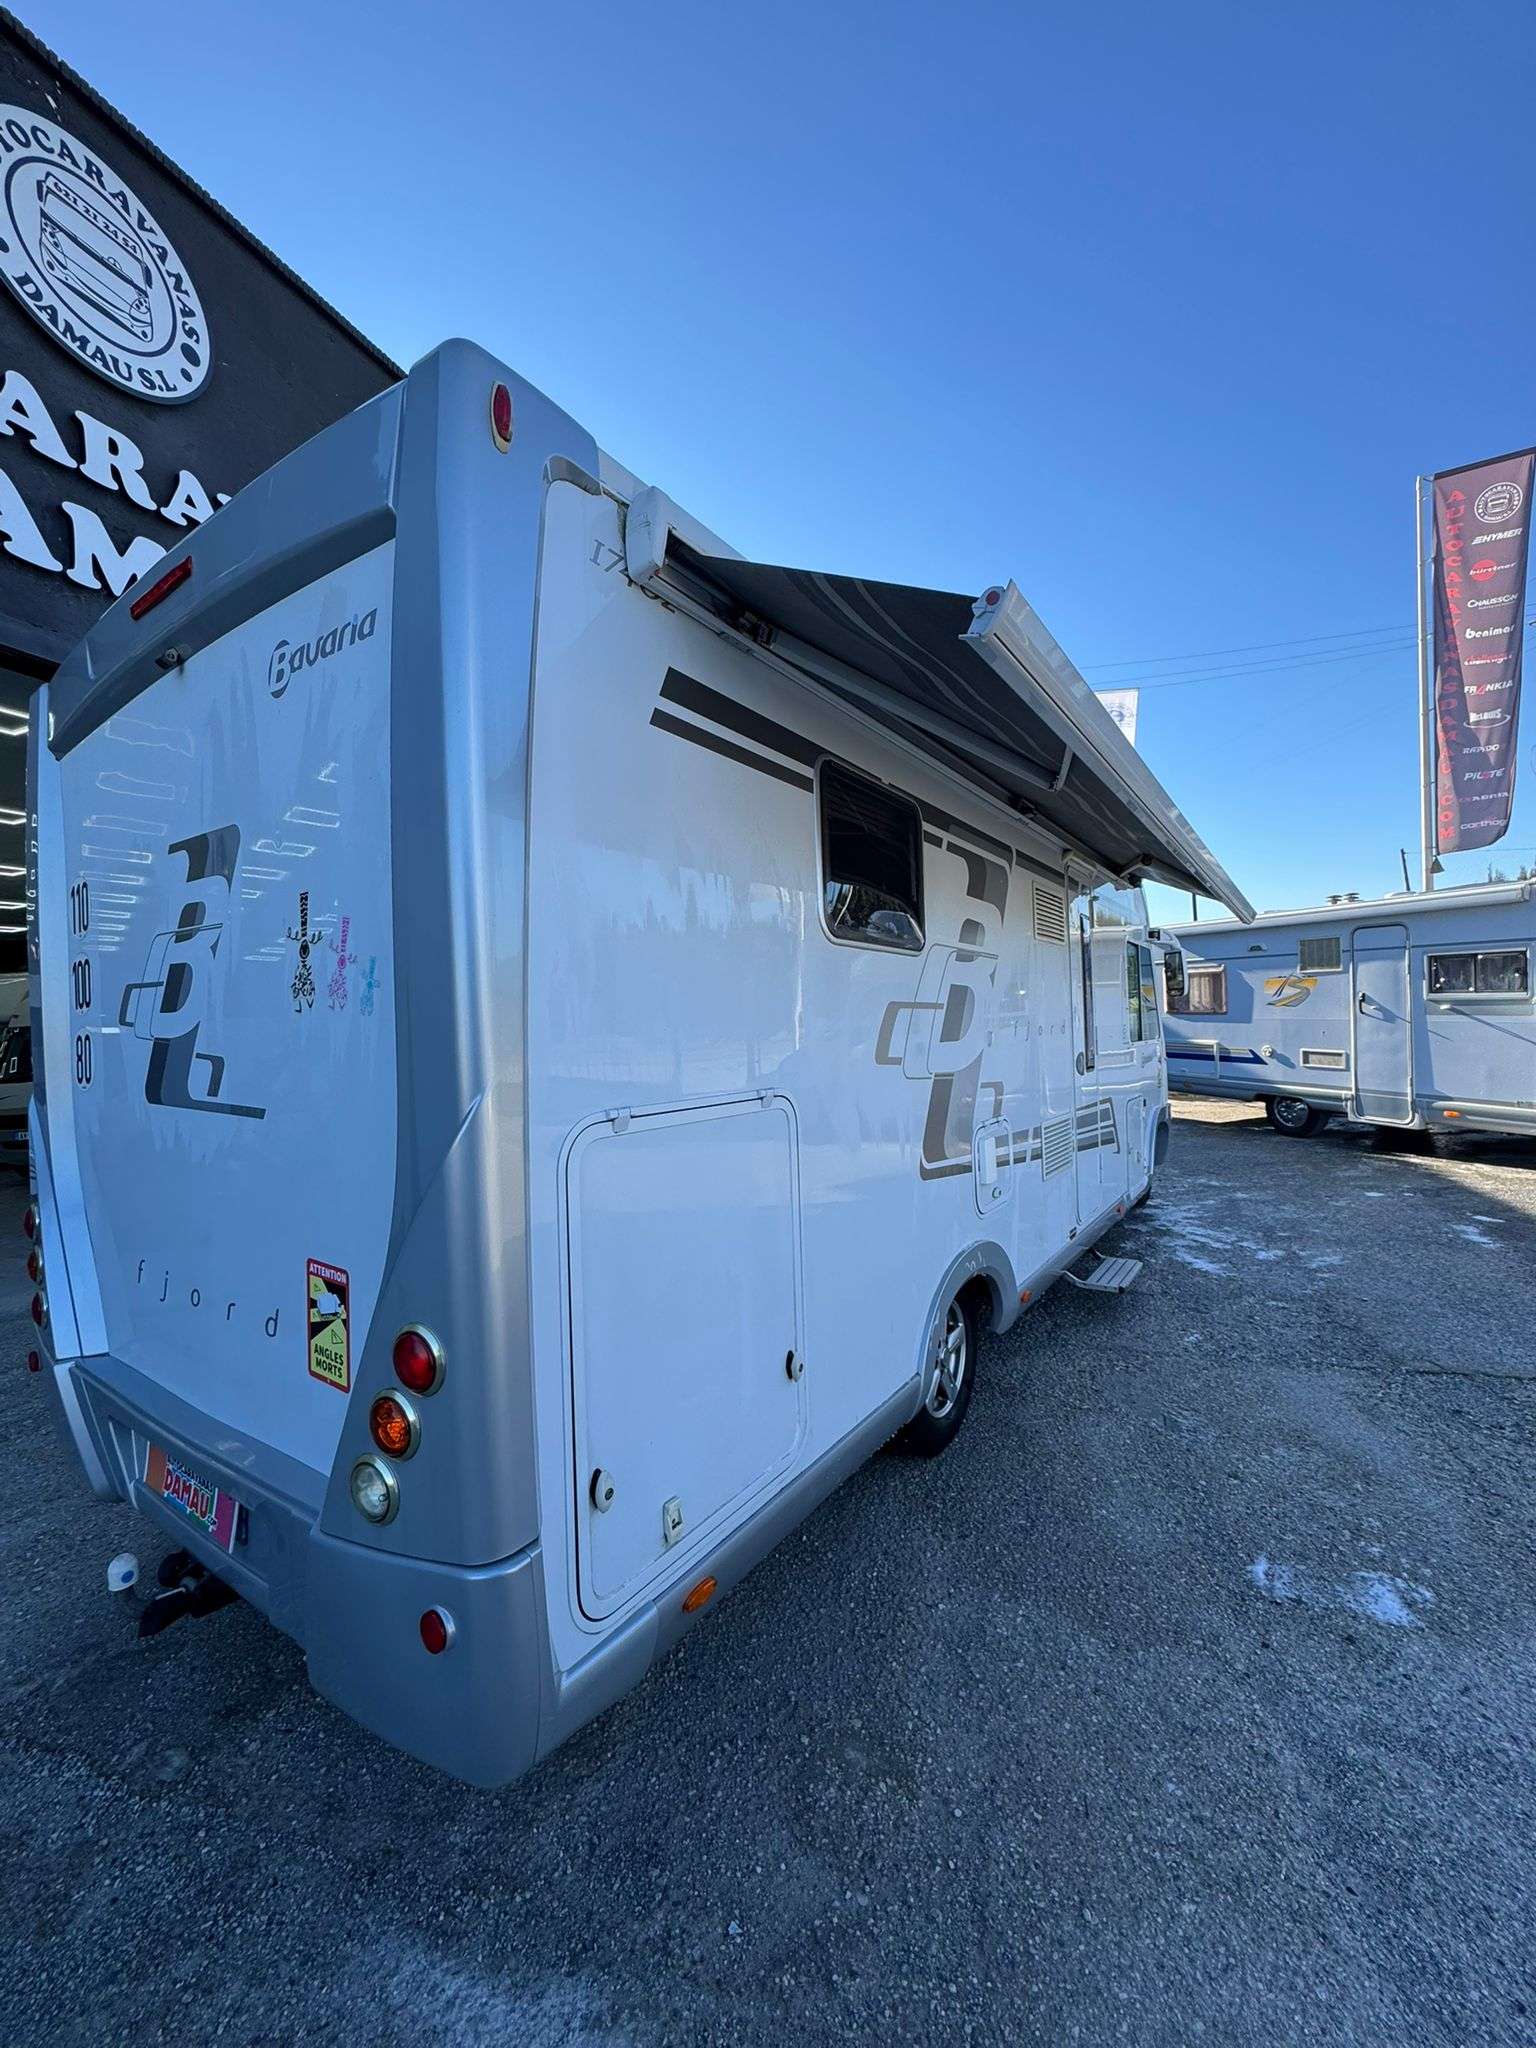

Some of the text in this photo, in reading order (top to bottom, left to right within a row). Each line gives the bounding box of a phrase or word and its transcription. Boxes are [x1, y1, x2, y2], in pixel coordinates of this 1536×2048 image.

[53, 181, 138, 254] 621 21 24 54
[12, 271, 134, 382] DAMAU
[0, 370, 232, 526] ARA
[268, 607, 378, 699] Bavaria
[1465, 625, 1515, 639] benimar
[70, 881, 90, 936] 110
[72, 957, 92, 1011] 100
[75, 1033, 92, 1085] 80
[309, 1262, 347, 1284] ATTENTION
[313, 1343, 344, 1365] ANGLES
[315, 1356, 343, 1379] MORTS
[162, 1466, 212, 1520] DAMAU
